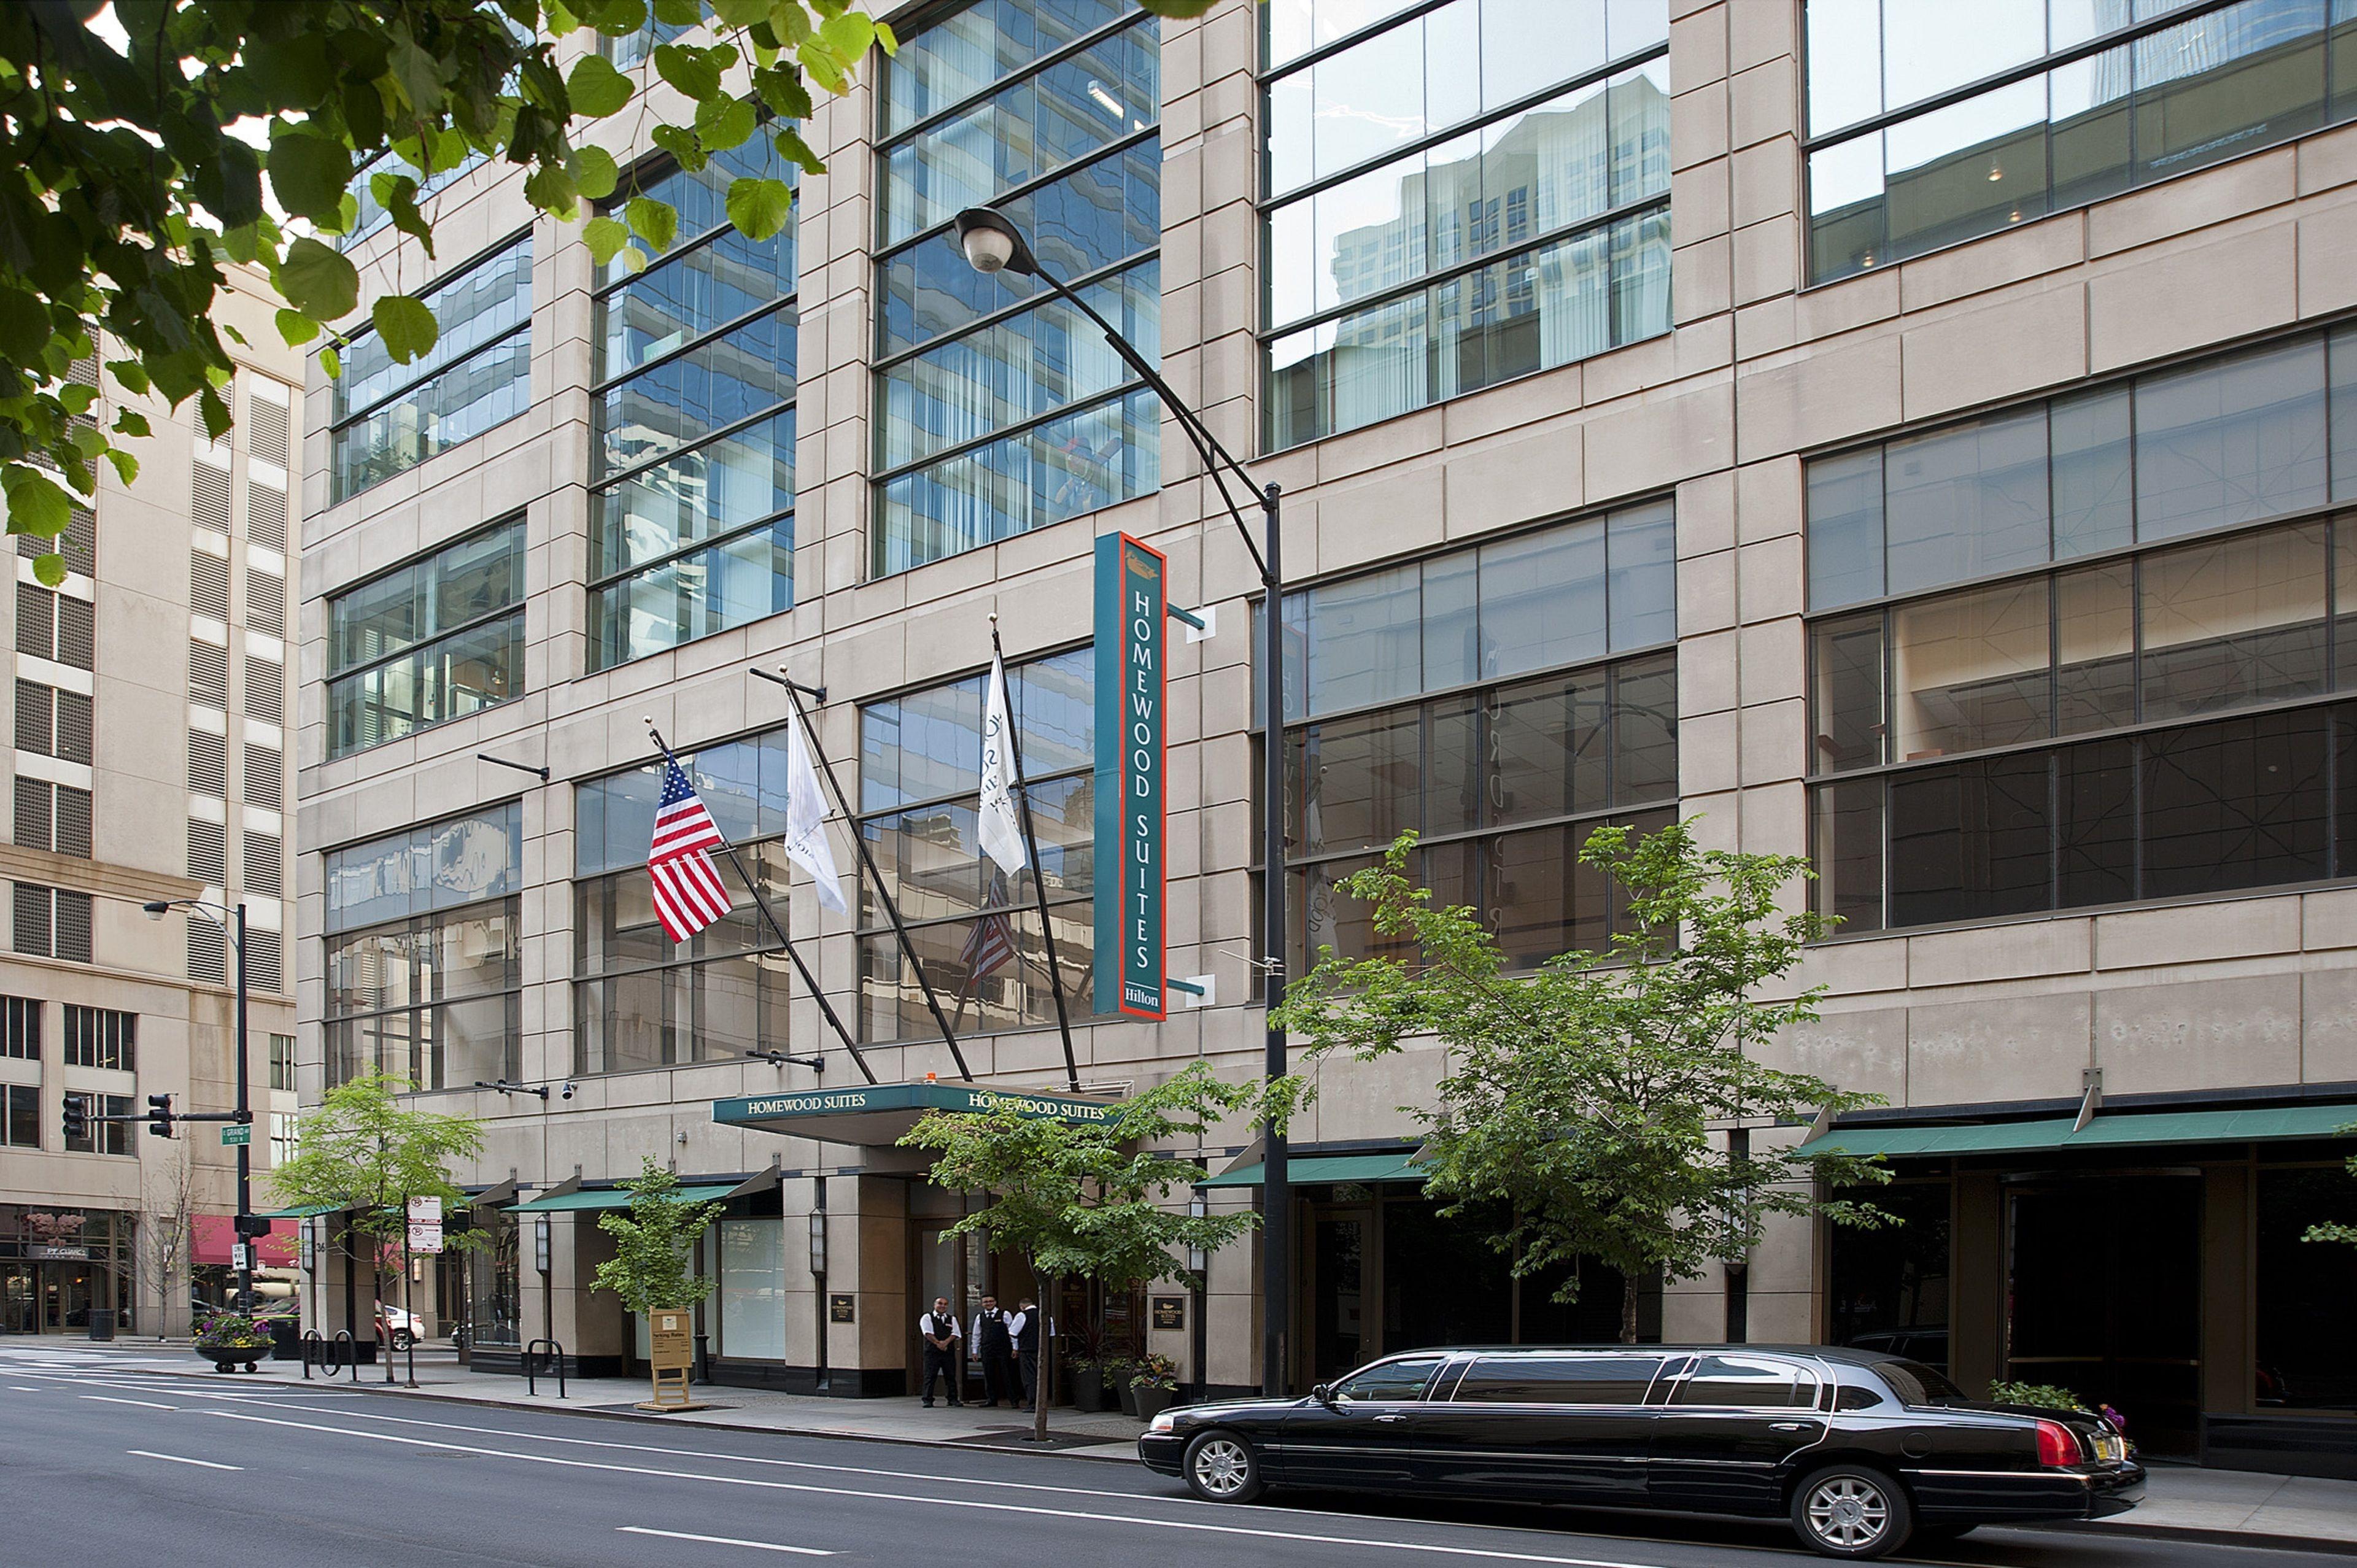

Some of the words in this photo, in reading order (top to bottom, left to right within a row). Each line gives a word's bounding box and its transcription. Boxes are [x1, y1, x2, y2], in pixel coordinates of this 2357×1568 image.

[1132, 590, 1153, 798] HOMEWOOD
[1136, 814, 1149, 968] SUITES
[1125, 988, 1159, 1007] Hilton
[748, 1097, 821, 1114] HOMEWOOD
[824, 1093, 866, 1110] SUITES
[1060, 1103, 1105, 1121] SUITES
[227, 1127, 244, 1137] GRAND
[316, 1242, 325, 1252] 36
